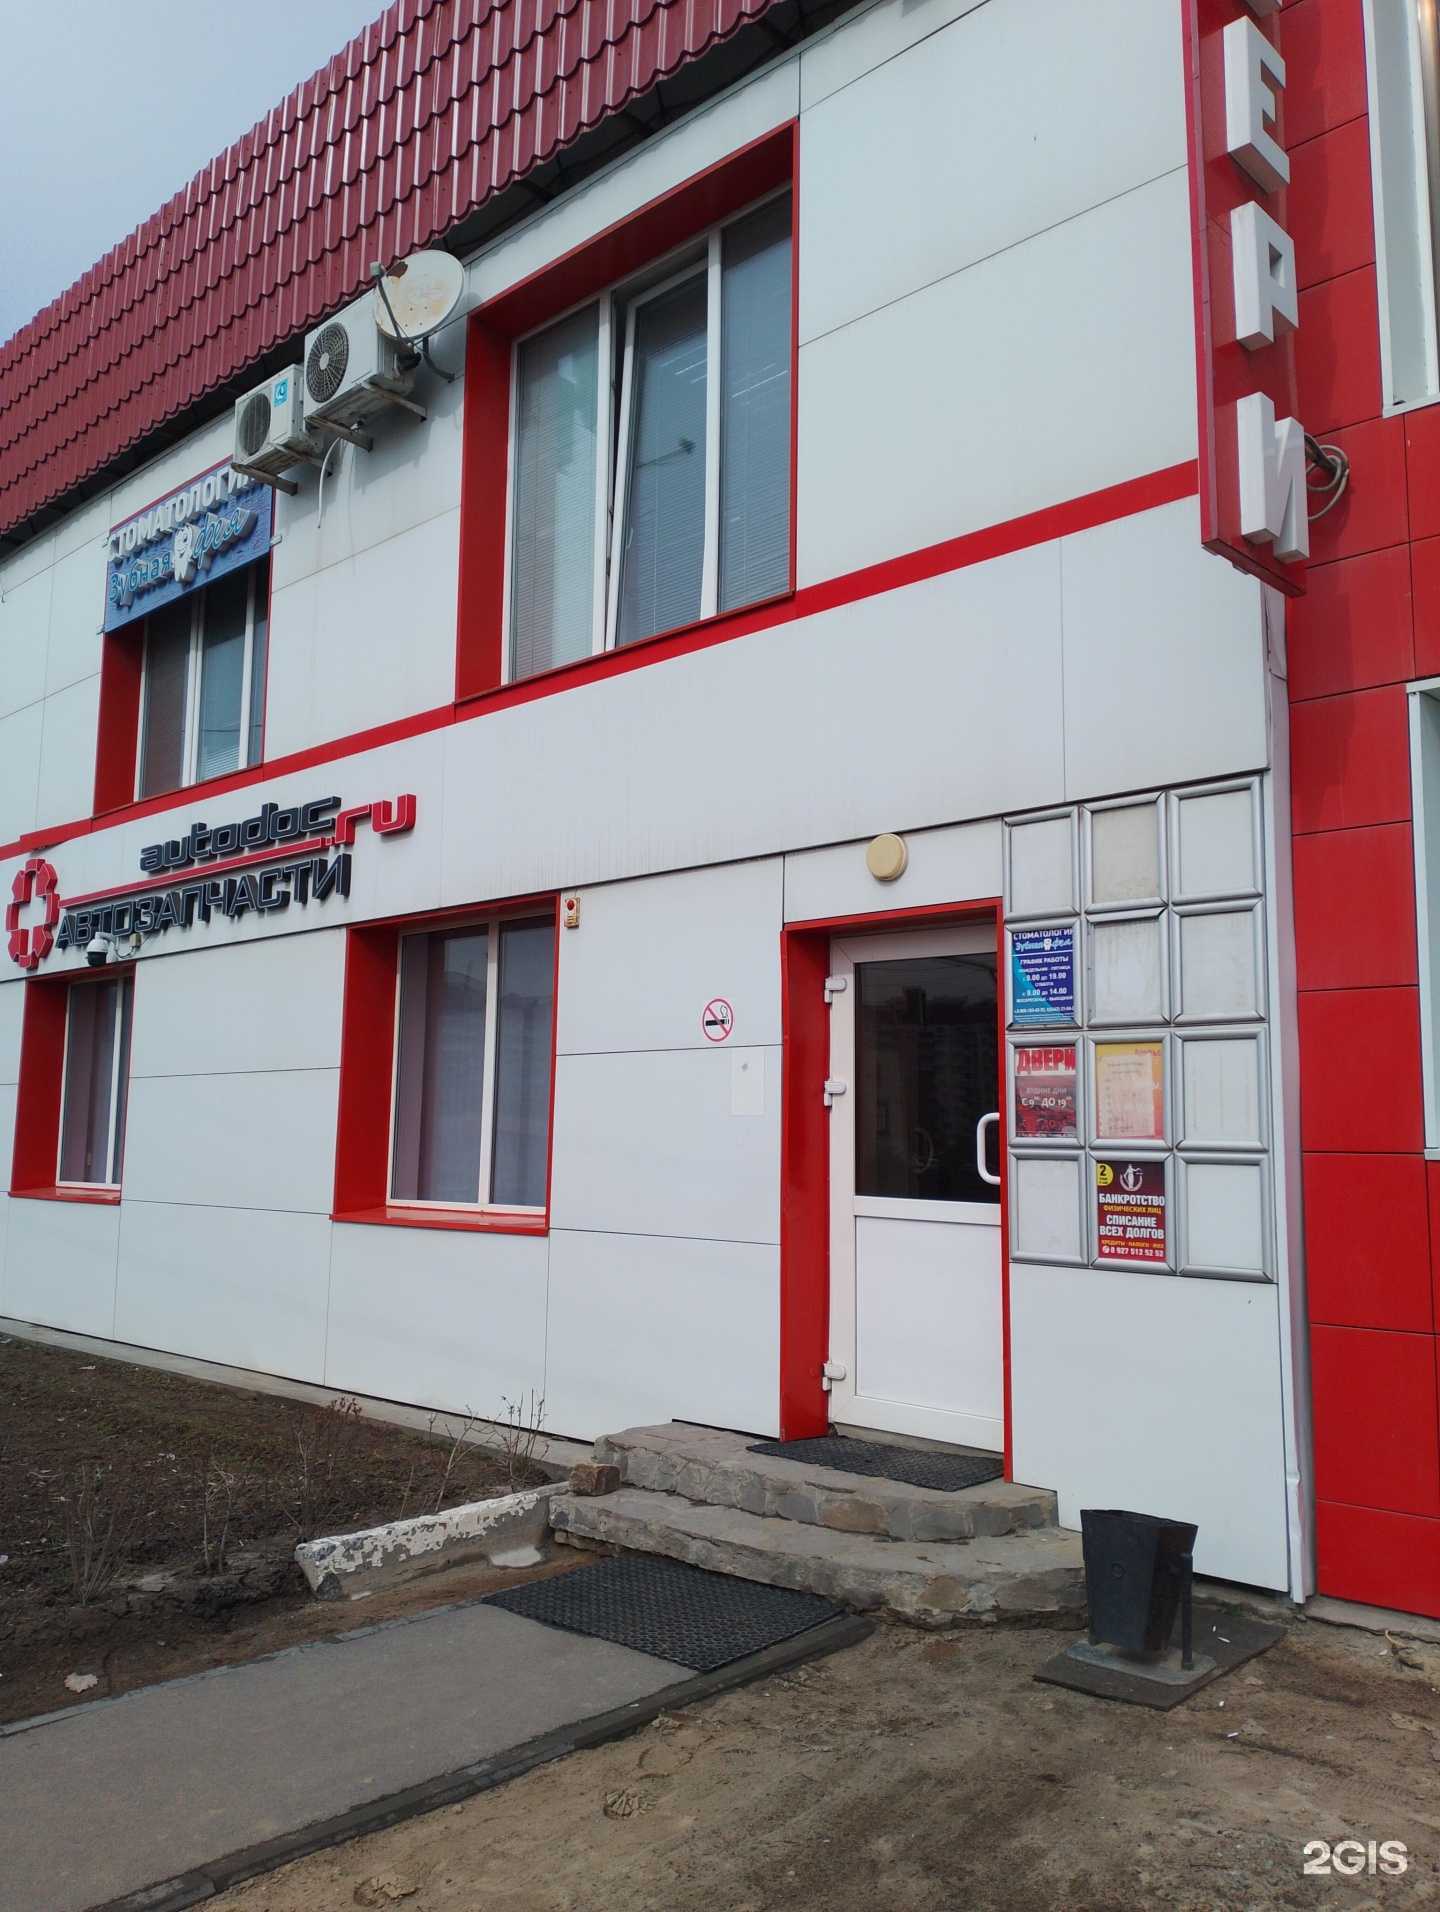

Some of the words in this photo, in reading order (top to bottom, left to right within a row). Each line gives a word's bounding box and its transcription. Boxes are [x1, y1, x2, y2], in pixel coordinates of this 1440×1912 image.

[107, 464, 255, 562] СТОМАТОЛОГИ
[140, 794, 416, 872] autodoc.ru
[55, 853, 352, 949] АВТОЗАПЧАСТИ
[1017, 1048, 1076, 1075] ДВЕРИ
[1099, 1165, 1106, 1176] 2
[1099, 1193, 1165, 1206] БАНКРОТСТВО
[1106, 1215, 1157, 1227] СПИСАНИЕ
[1099, 1226, 1124, 1236] ВСЕХ
[1125, 1227, 1165, 1239] ДОЛГОВ
